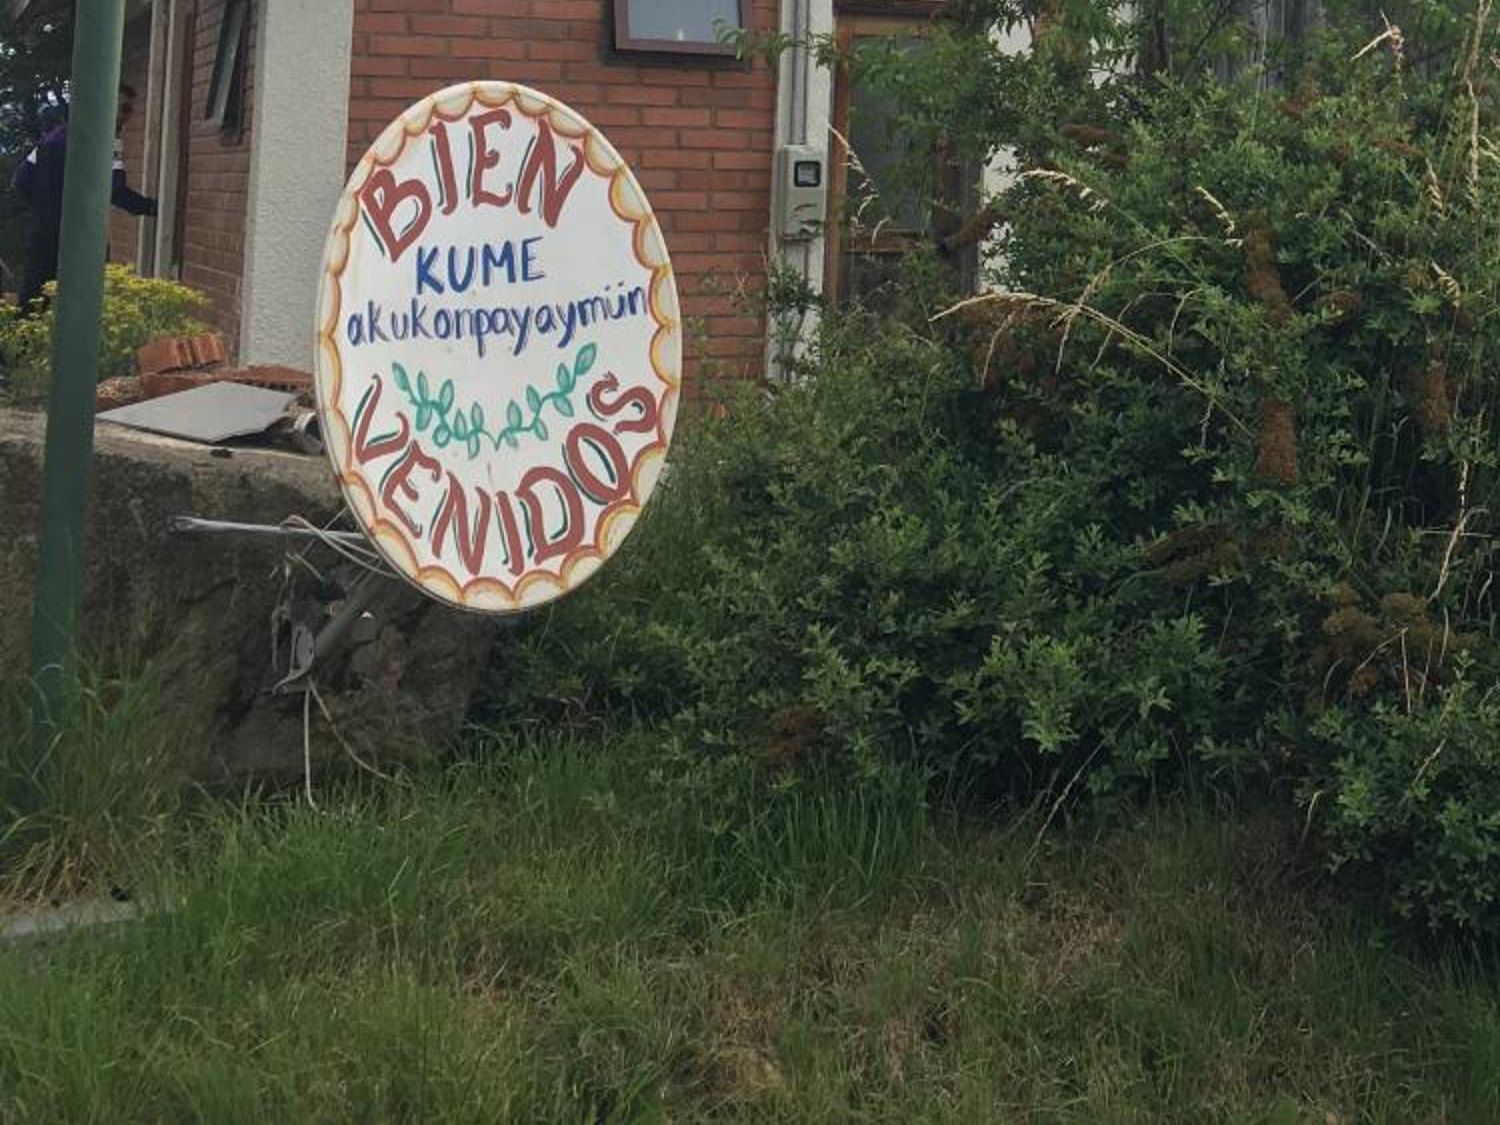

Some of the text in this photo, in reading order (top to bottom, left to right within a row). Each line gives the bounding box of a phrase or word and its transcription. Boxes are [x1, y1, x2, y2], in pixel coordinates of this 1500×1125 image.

[361, 108, 585, 263] BIEN
[415, 236, 546, 295] KUME
[351, 371, 658, 576] VENIDOS
